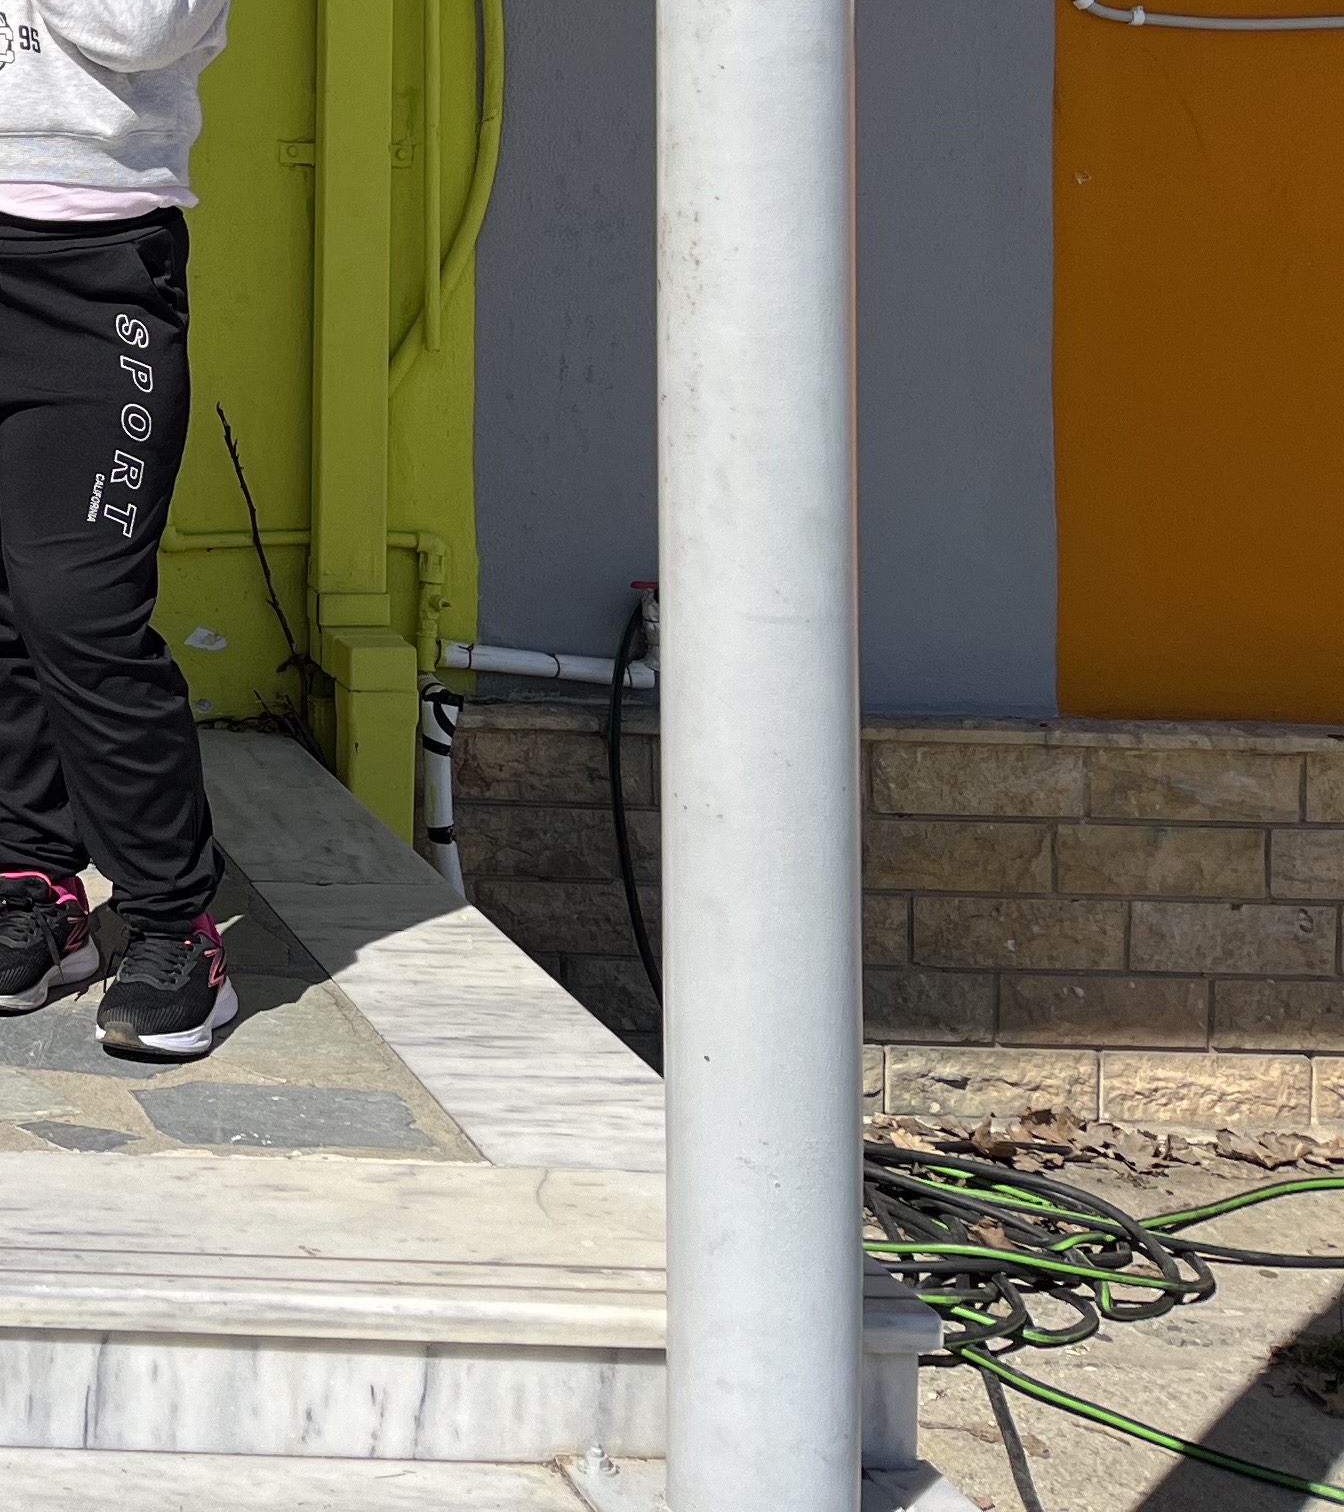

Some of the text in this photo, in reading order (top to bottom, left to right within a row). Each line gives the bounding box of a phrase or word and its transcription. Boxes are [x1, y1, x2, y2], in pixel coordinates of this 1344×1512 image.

[18, 24, 42, 54] 95
[103, 313, 154, 538] SPORT
[86, 472, 105, 523] CALIFORNIA
